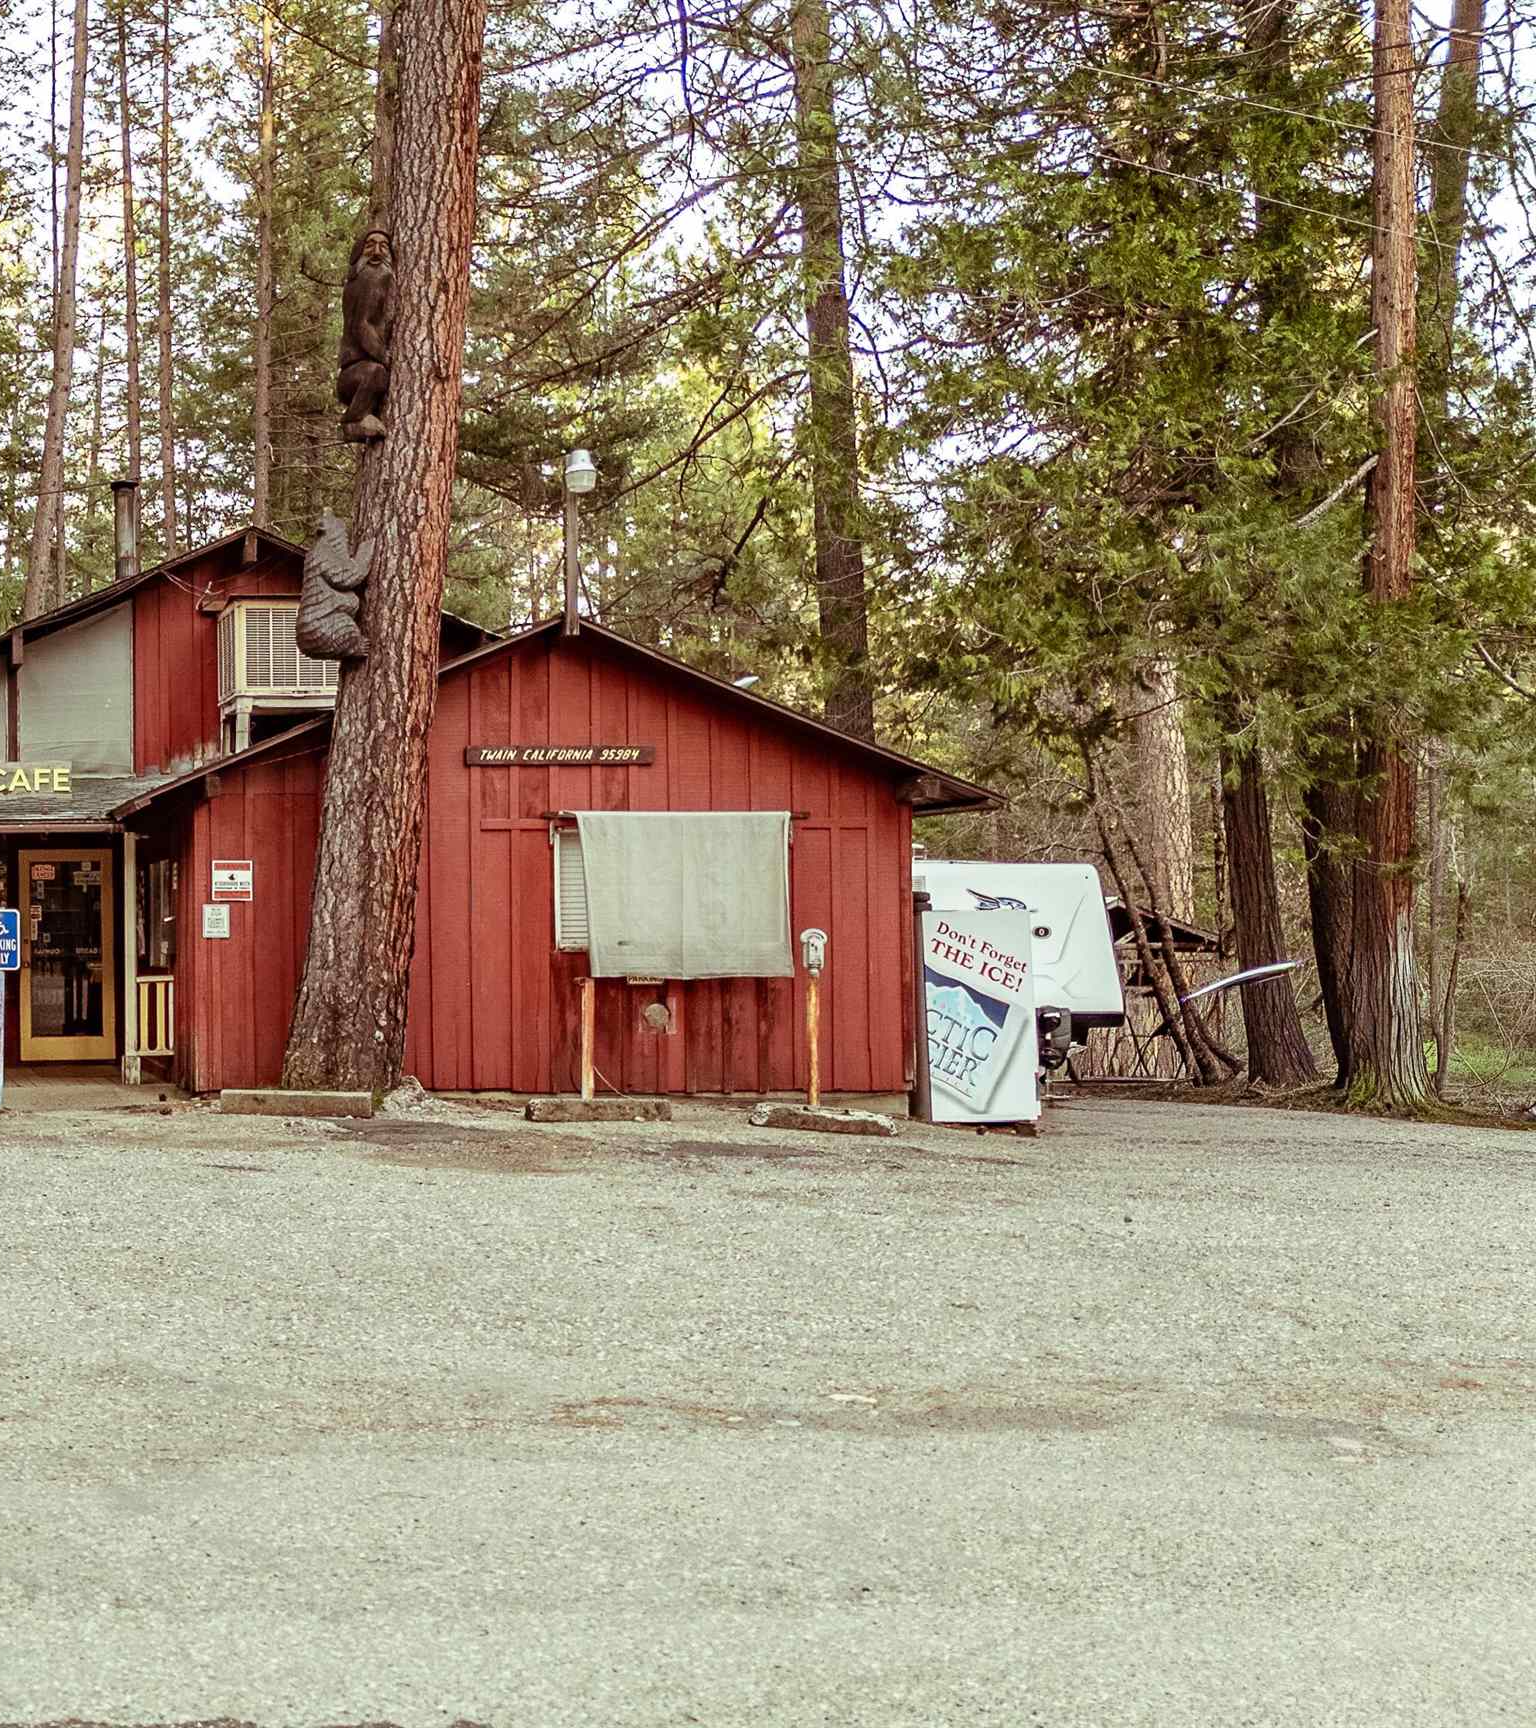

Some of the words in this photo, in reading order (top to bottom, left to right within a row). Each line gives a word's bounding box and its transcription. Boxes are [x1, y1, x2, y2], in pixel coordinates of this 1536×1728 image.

[480, 749, 517, 760] TWAIN
[523, 749, 593, 760] CALIFORNIA
[600, 749, 640, 761] 95984
[930, 938, 974, 970] THE
[979, 962, 1023, 992] ICE!
[936, 921, 977, 949] Don't
[979, 942, 1027, 973] Forget
